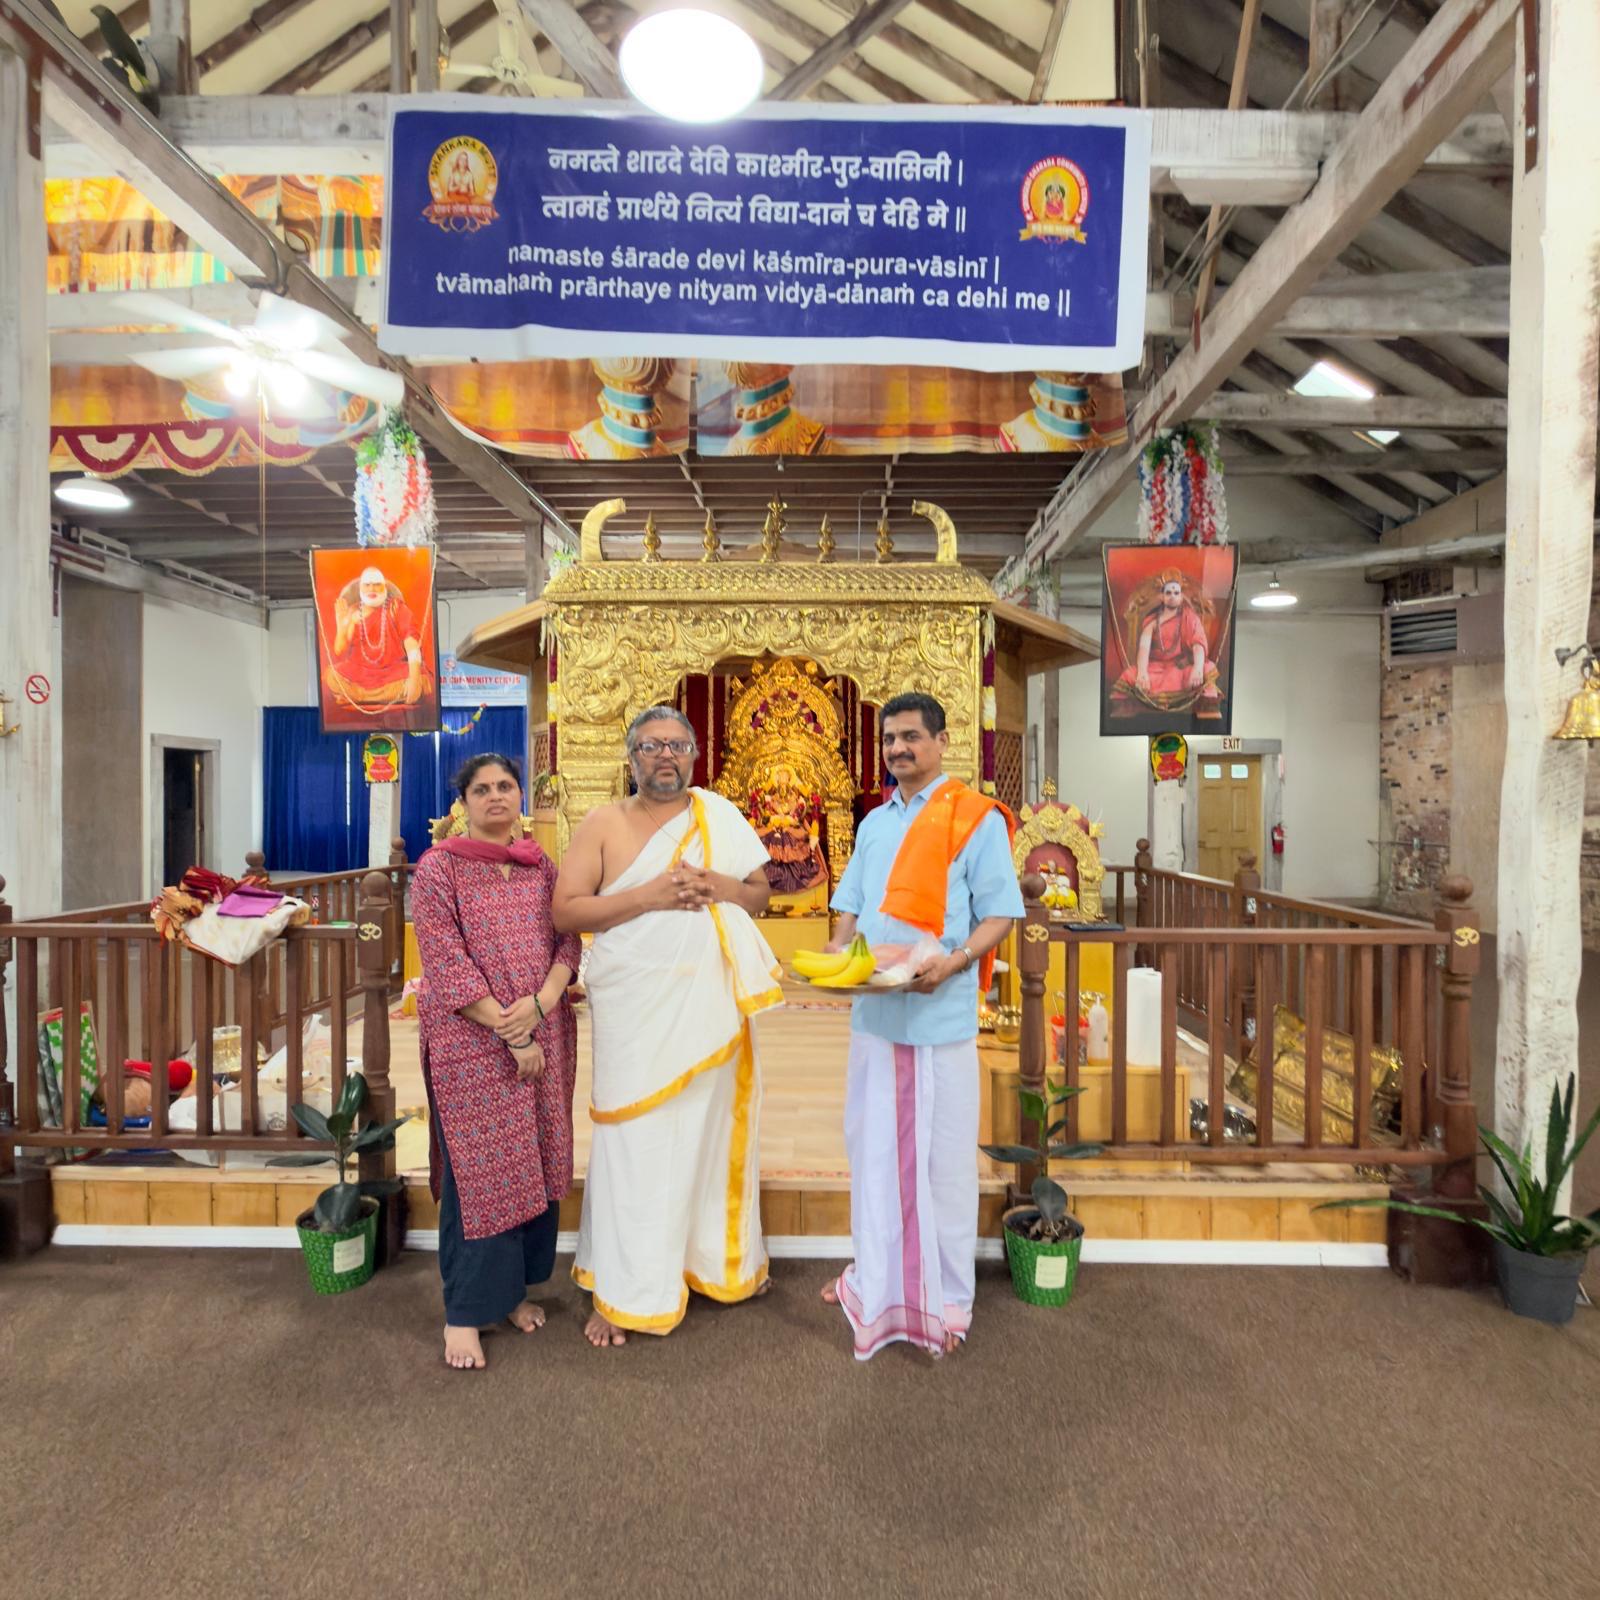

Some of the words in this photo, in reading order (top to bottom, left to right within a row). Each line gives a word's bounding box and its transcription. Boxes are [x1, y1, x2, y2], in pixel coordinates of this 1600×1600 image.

[548, 143, 620, 173] नमस्ते
[627, 145, 683, 175] शारदे
[689, 144, 730, 176] देवि
[735, 147, 951, 188] काश्मीर-पुर-वासिनी
[541, 190, 611, 222] त्वामहं
[616, 190, 681, 222] प्रार्थये
[686, 191, 743, 224] नित्यं
[749, 194, 851, 227] विद्या-दानं
[856, 203, 877, 228] च
[882, 197, 922, 231] देहि
[926, 198, 949, 229] मे
[508, 244, 604, 269] namaste
[611, 245, 689, 269] śārade
[697, 247, 745, 271] devi
[560, 275, 672, 304] prārthaye
[679, 278, 758, 306] nityam
[922, 289, 949, 307] ca
[956, 285, 1008, 309] dehi
[1015, 290, 1050, 311] me
[1223, 738, 1240, 750] EXIT
